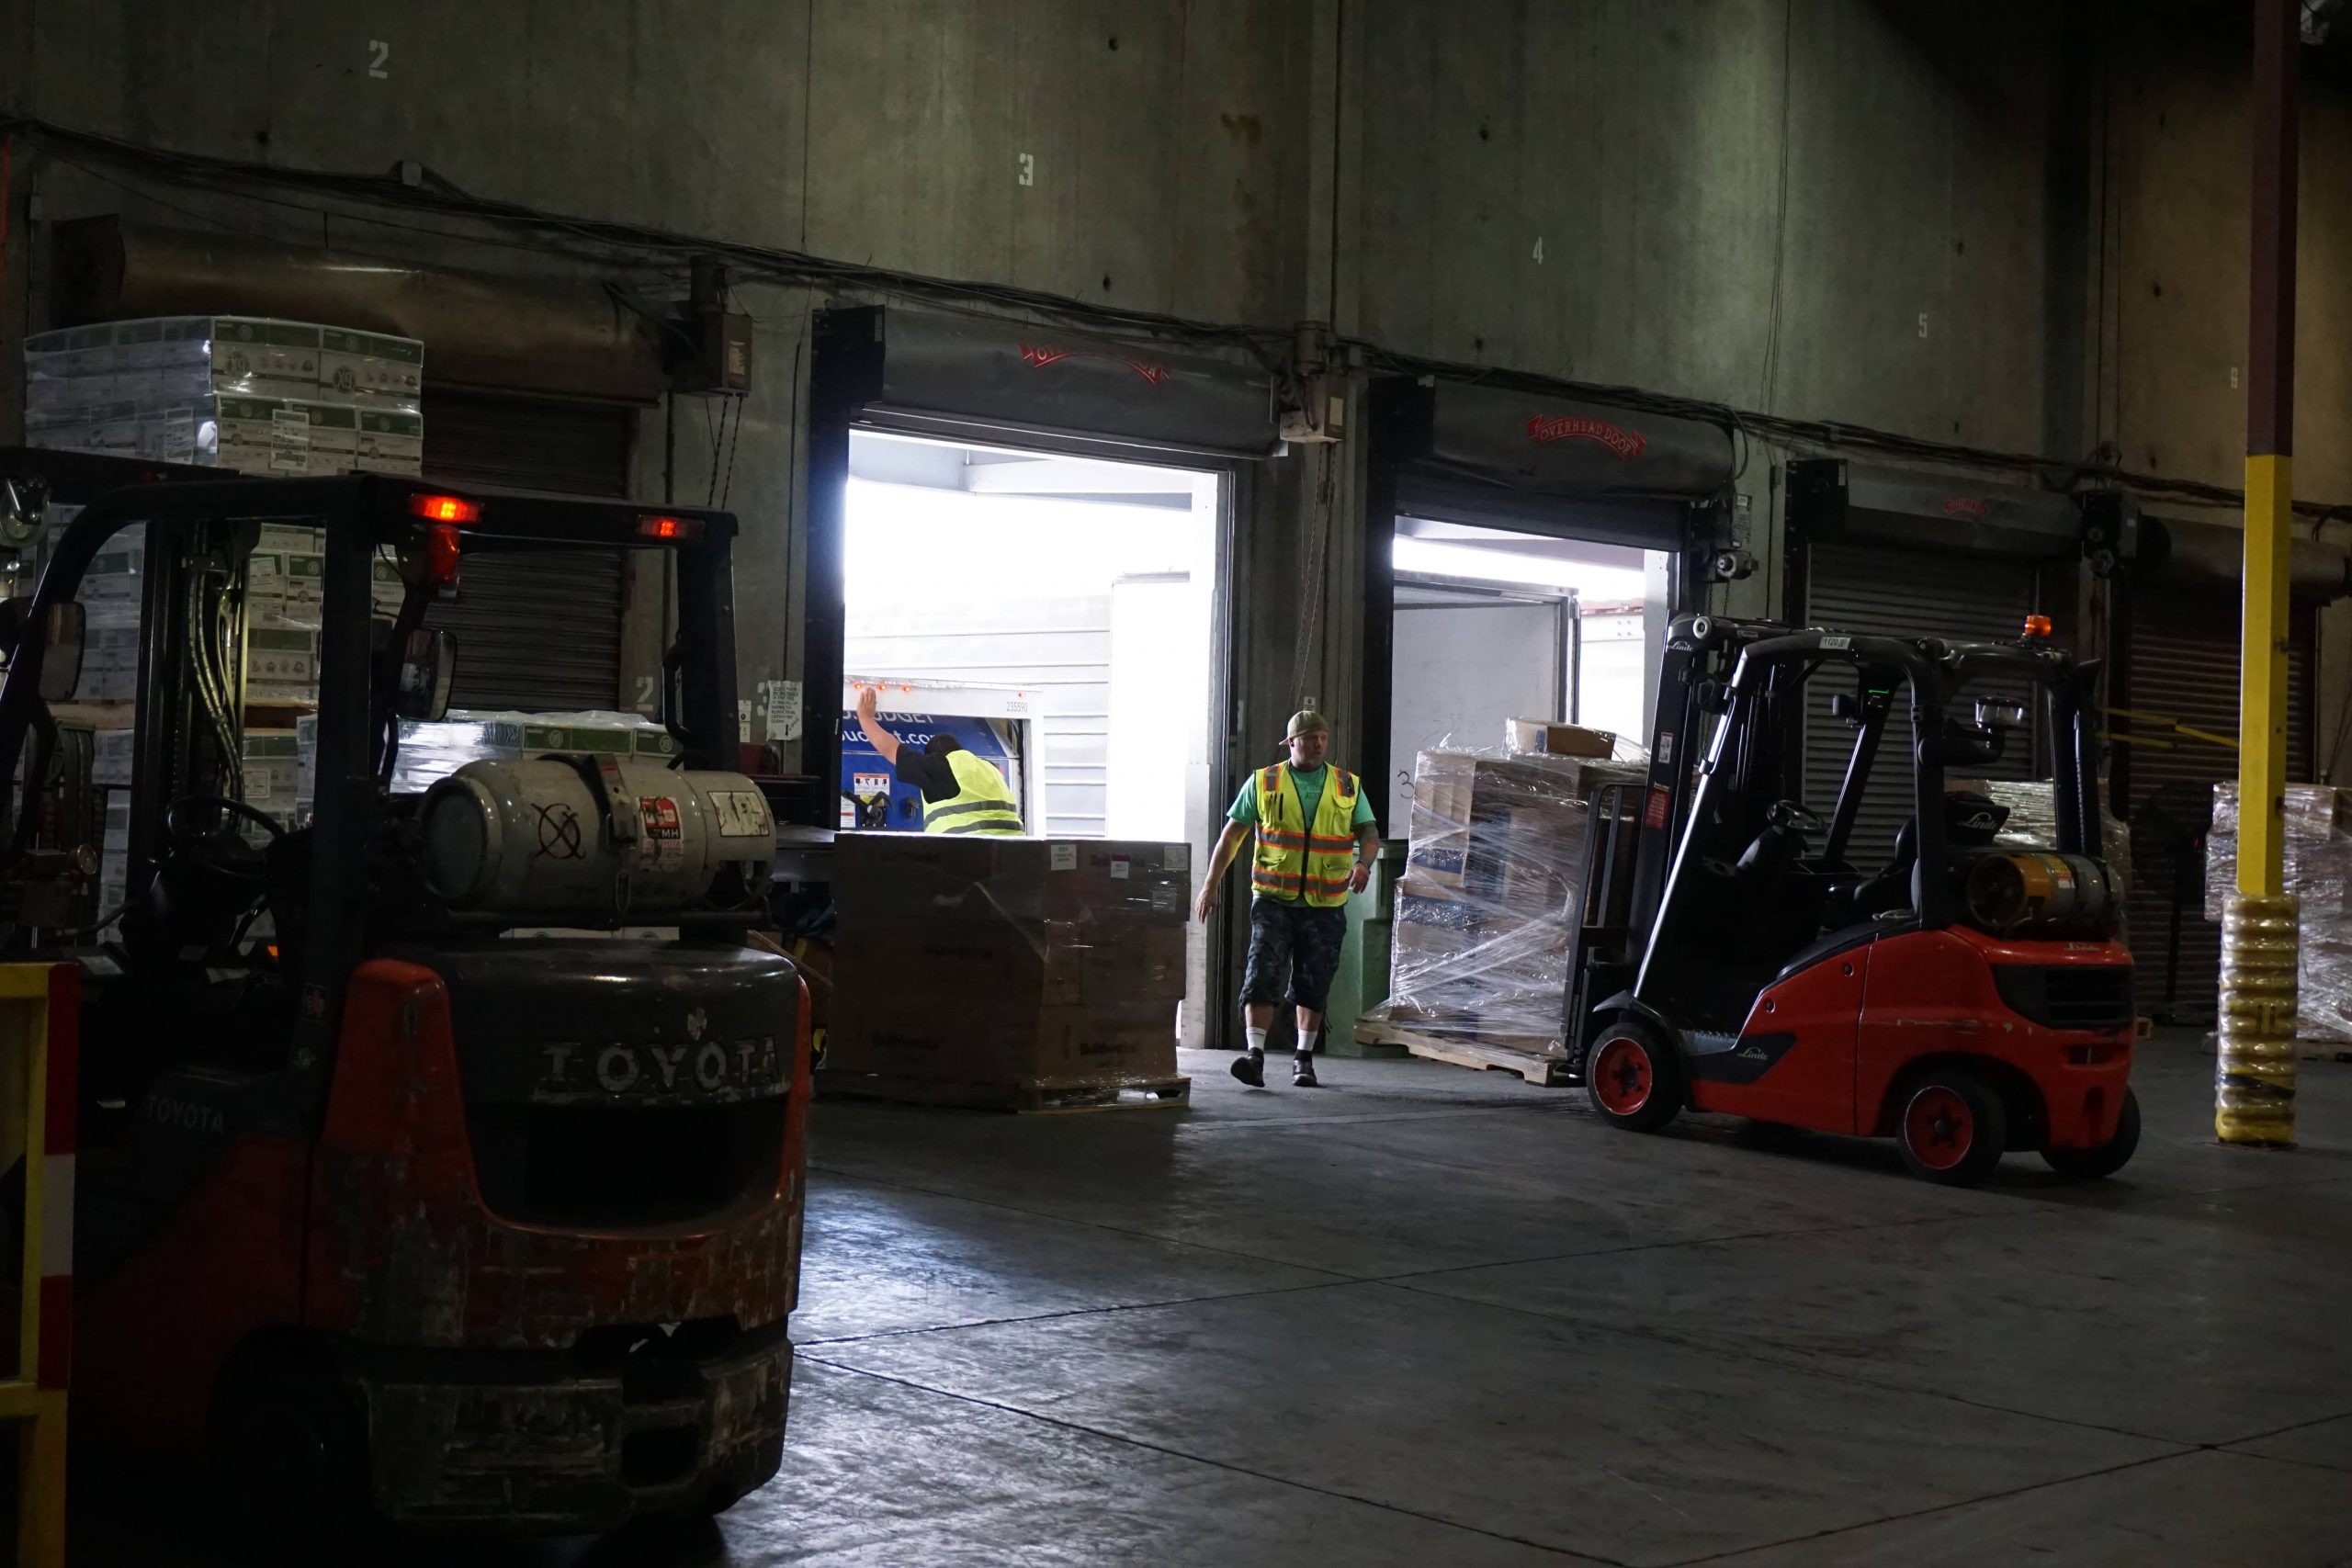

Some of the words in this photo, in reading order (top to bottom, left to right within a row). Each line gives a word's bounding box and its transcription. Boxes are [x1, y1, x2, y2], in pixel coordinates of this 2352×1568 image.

[368, 39, 389, 79] 2
[1017, 152, 1035, 187] 3
[1532, 235, 1544, 265] 4
[1917, 312, 1928, 338] 5
[1540, 419, 1603, 441] OVERHEAD
[1603, 427, 1633, 457] DOOR
[1668, 640, 1695, 652] Linde
[636, 676, 653, 712] 2
[1397, 770, 1415, 799] 3
[1955, 811, 2000, 830] Linde
[541, 1034, 779, 1092] TOYOTA
[1736, 1046, 1769, 1060] Linde
[147, 1094, 225, 1135] TOYOTA
